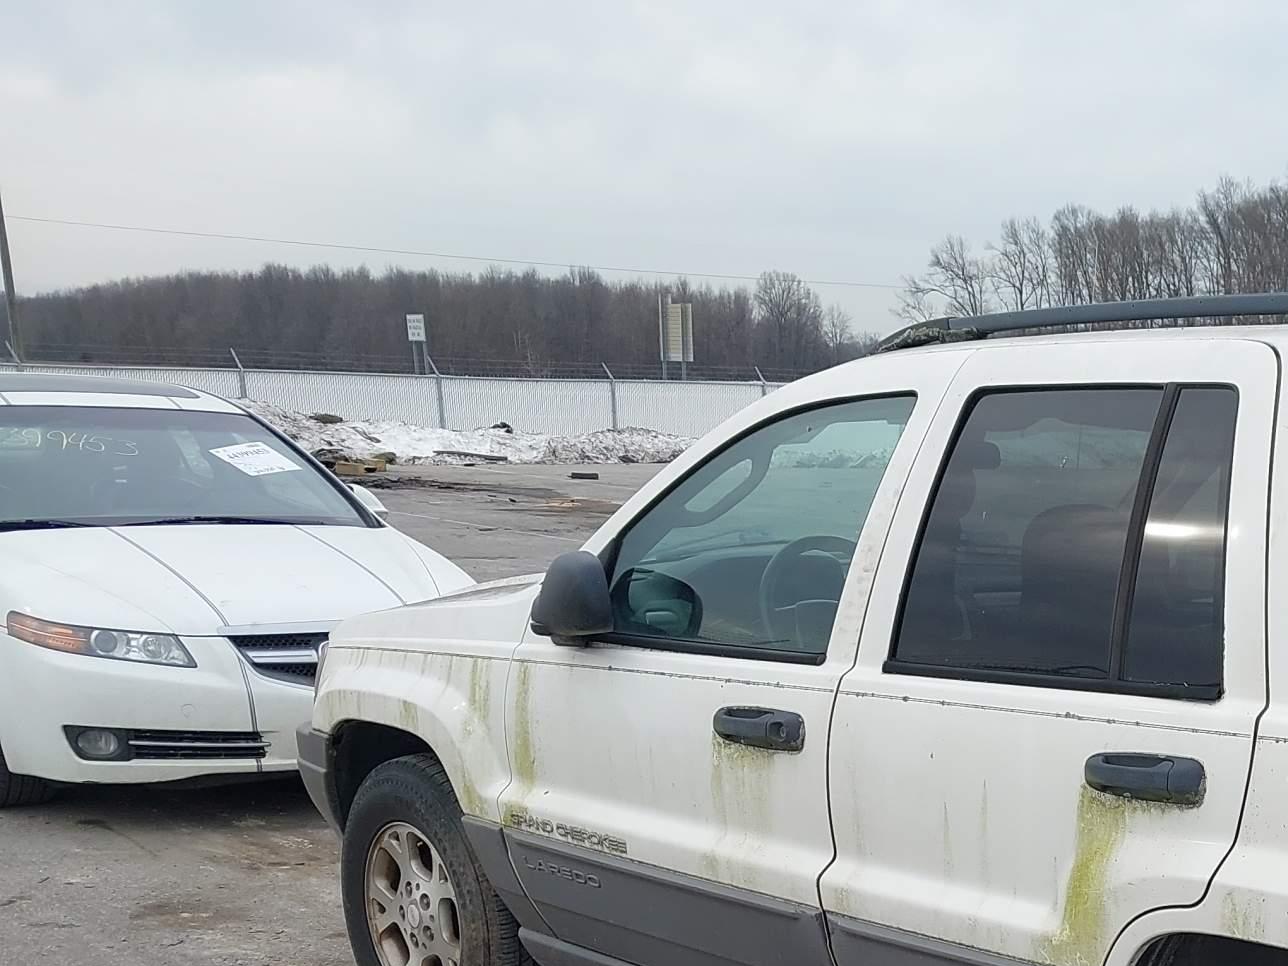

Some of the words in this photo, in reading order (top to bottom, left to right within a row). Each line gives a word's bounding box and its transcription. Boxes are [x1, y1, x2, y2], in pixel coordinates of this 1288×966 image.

[510, 813, 554, 834] GRAND
[555, 821, 629, 855] CHEROKEE
[521, 854, 602, 889] LAREDO
